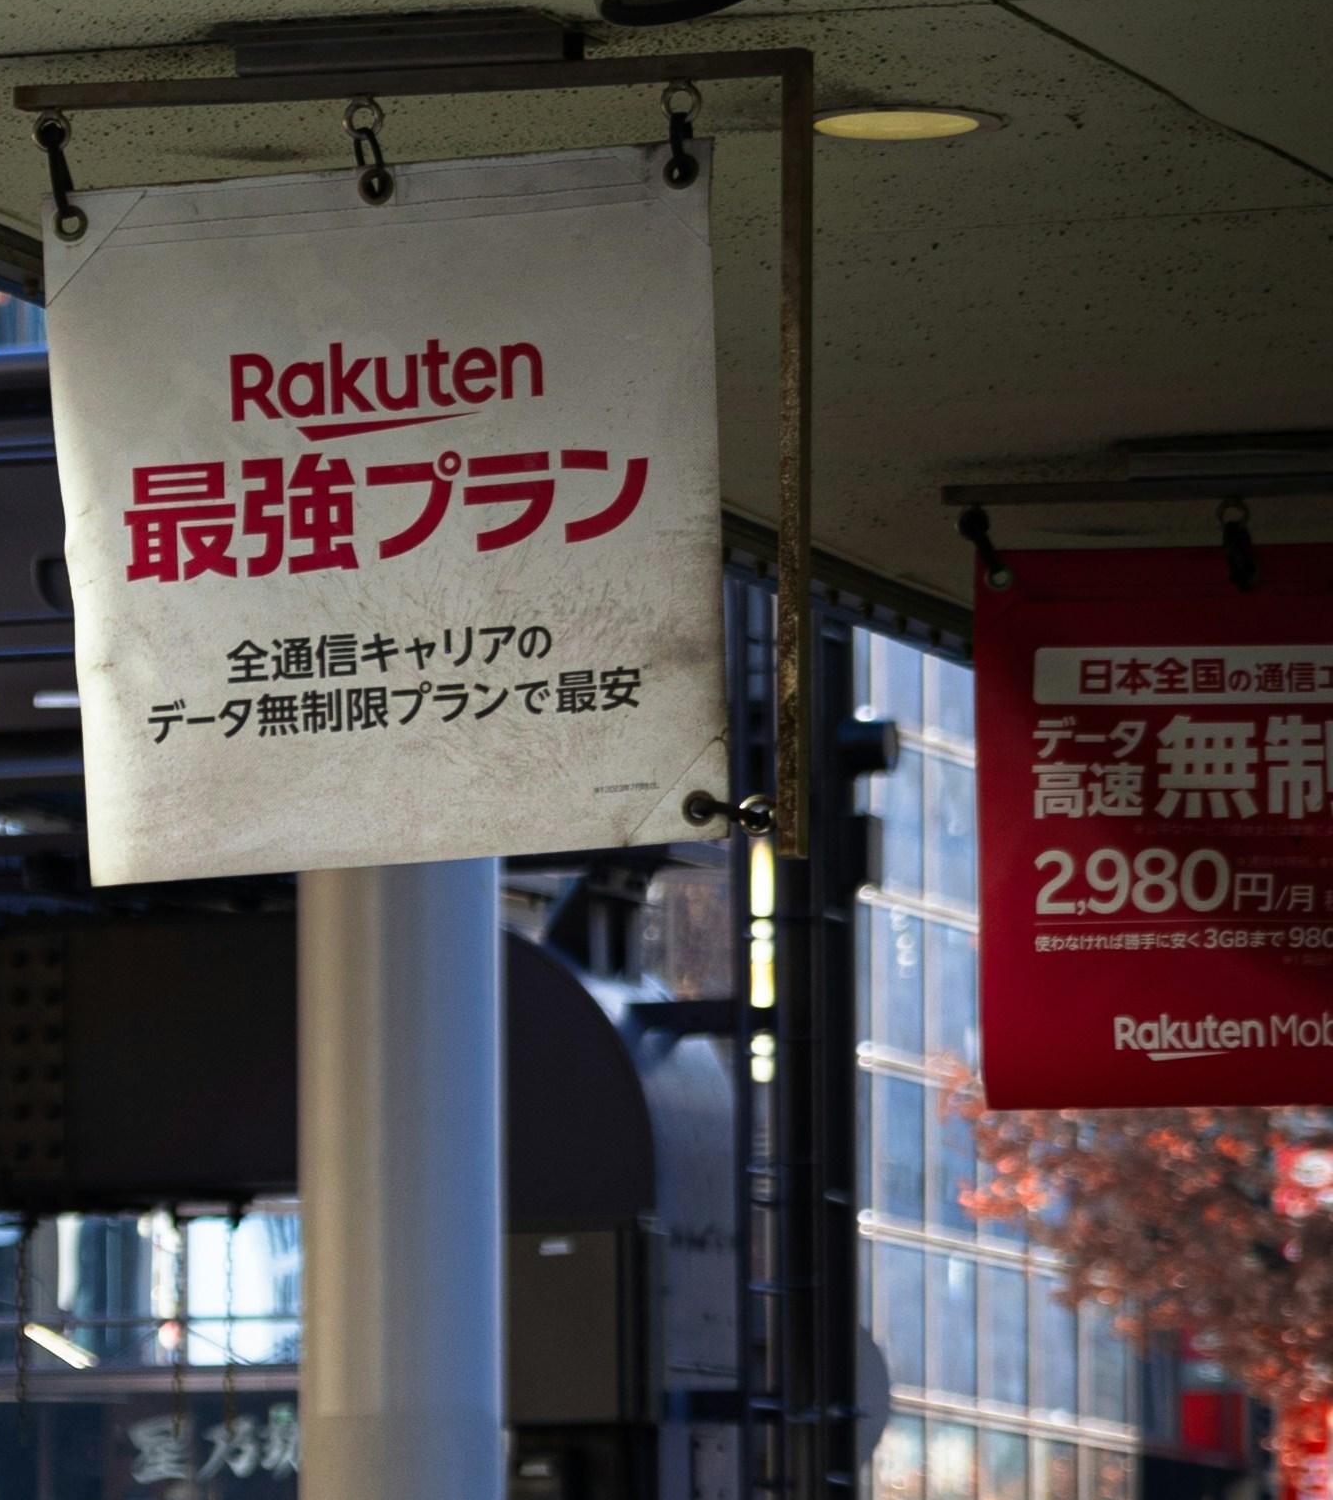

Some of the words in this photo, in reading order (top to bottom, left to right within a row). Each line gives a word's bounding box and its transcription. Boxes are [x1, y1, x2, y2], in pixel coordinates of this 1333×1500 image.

[230, 339, 544, 422] Rakuten
[123, 450, 649, 583] 最強プラン
[227, 623, 553, 685] 全通信キャリアの
[147, 665, 642, 744] データ無制限プランで最安
[1032, 715, 1147, 759] データ
[1032, 761, 1145, 819] 高速
[1113, 1012, 1265, 1051] Rakuten
